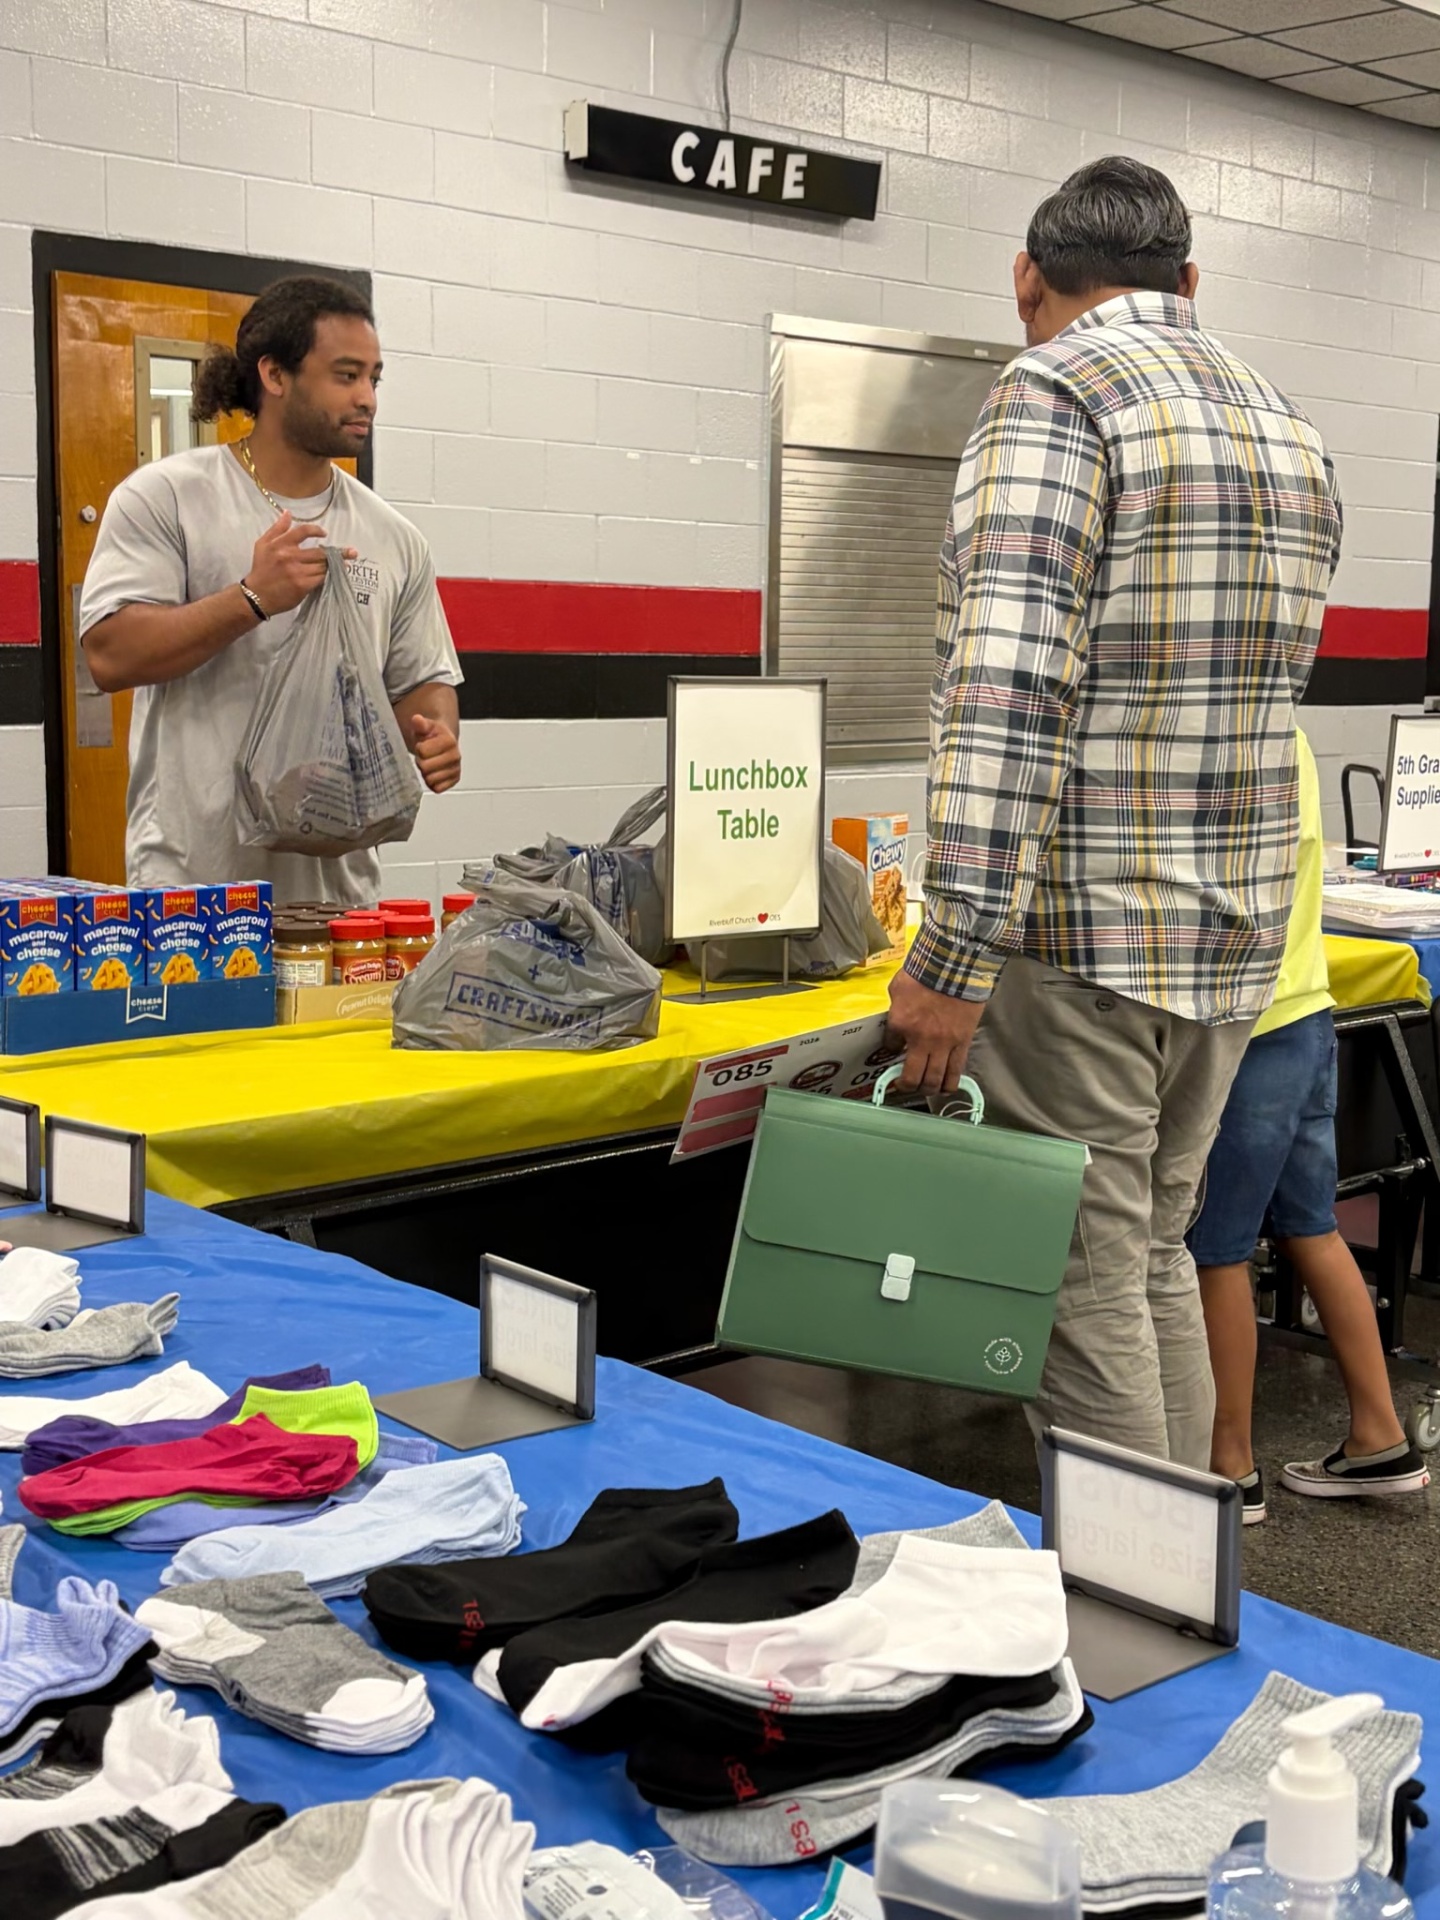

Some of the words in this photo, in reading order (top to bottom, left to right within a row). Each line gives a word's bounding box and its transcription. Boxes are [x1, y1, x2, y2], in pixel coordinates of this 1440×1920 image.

[671, 131, 808, 200] CAFE
[345, 564, 379, 581] ORTH
[1397, 754, 1415, 776] 5th
[689, 758, 808, 792] Lunchbox
[717, 808, 780, 840] Table
[871, 838, 906, 872] Chewy
[165, 897, 195, 906] cheese
[228, 891, 257, 900] cheese
[21, 903, 56, 914] cheese
[96, 900, 128, 910] cheese
[216, 915, 268, 932] macaroni
[734, 916, 757, 925] Church
[83, 925, 140, 943] macaroni
[152, 921, 207, 938] macaroni
[9, 930, 69, 947] macaroni
[160, 938, 200, 951] cheese
[223, 932, 262, 945] cheese
[16, 948, 61, 961] cheese
[91, 943, 133, 956] cheese
[130, 997, 162, 1007] cheese
[341, 997, 367, 1014] Peanut
[457, 984, 592, 1030] CRAFTSMAN
[712, 1059, 773, 1087] 085
